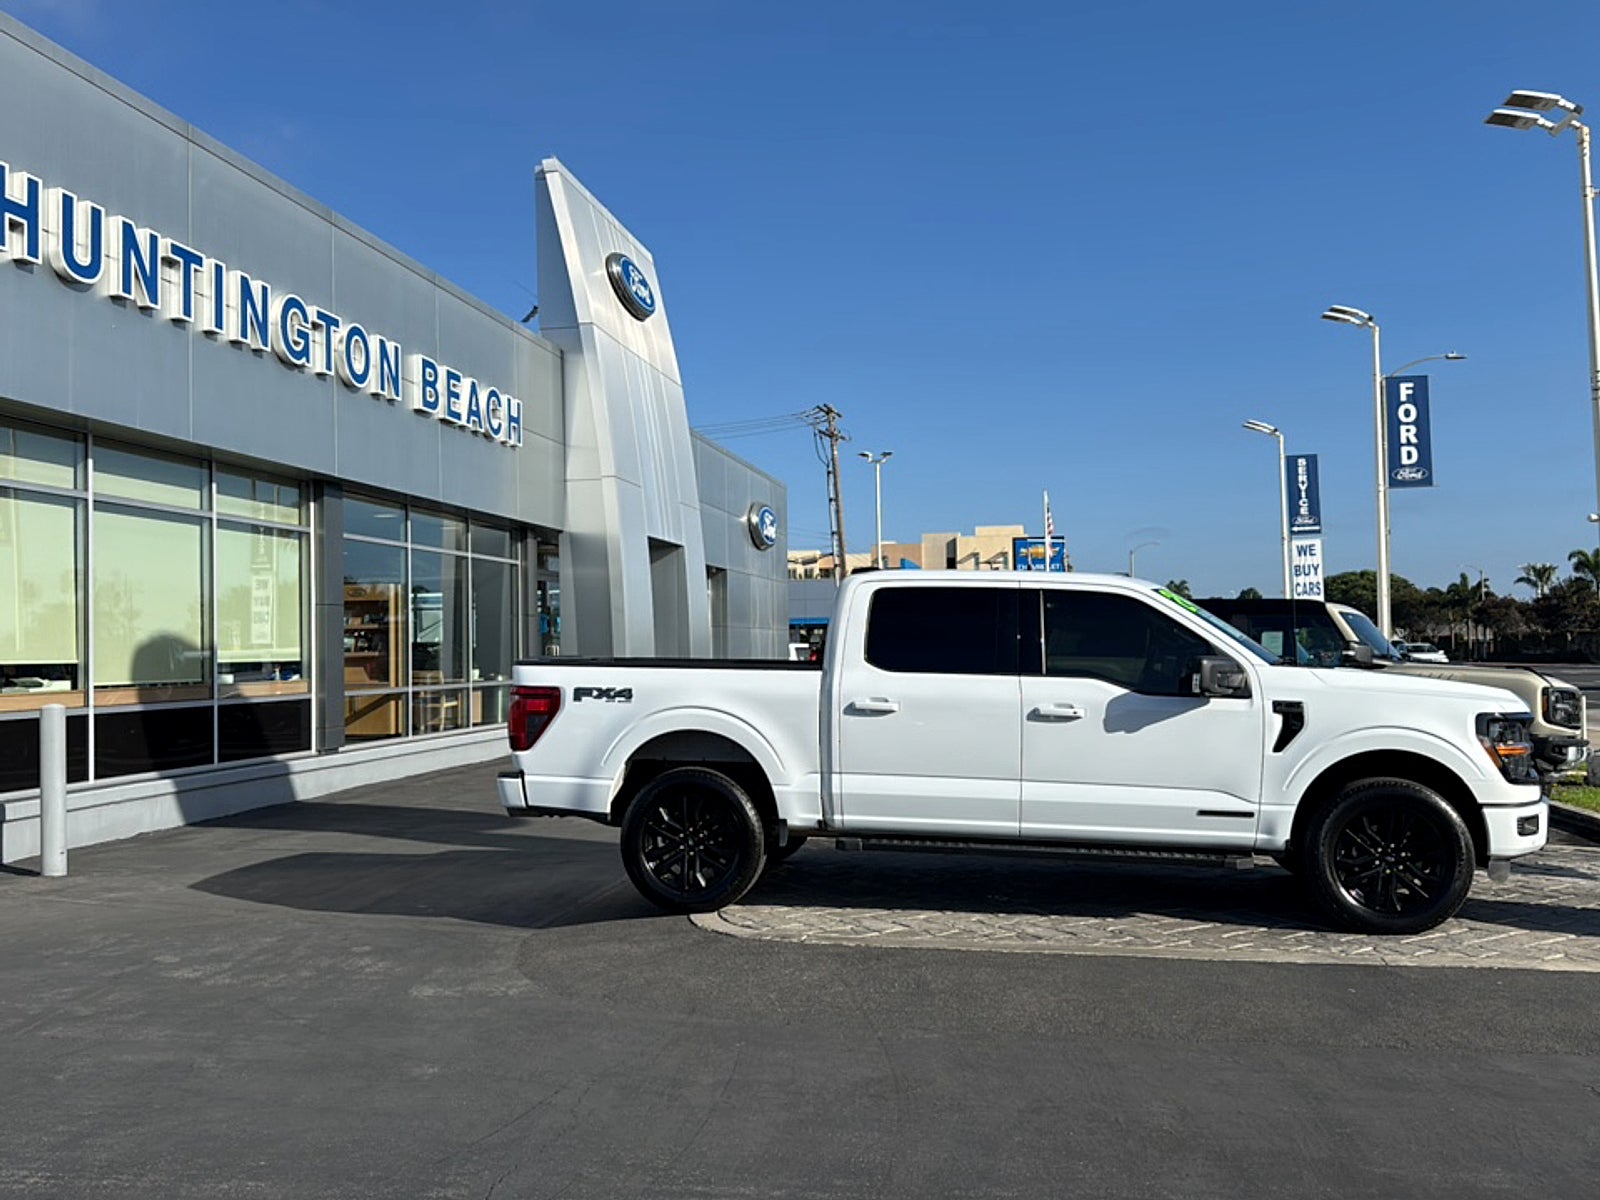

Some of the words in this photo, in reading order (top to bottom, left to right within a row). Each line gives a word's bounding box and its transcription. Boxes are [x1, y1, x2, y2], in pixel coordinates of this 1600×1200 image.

[0, 161, 402, 401] HUNTINGTON
[413, 353, 524, 448] BEACH
[1397, 382, 1419, 466] FORD
[1396, 467, 1424, 480] Ford
[1297, 458, 1309, 515] SERVICE
[1296, 543, 1317, 557] WE
[1294, 563, 1320, 577] BUY
[1295, 581, 1321, 597] CARS
[573, 686, 633, 702] FX4
